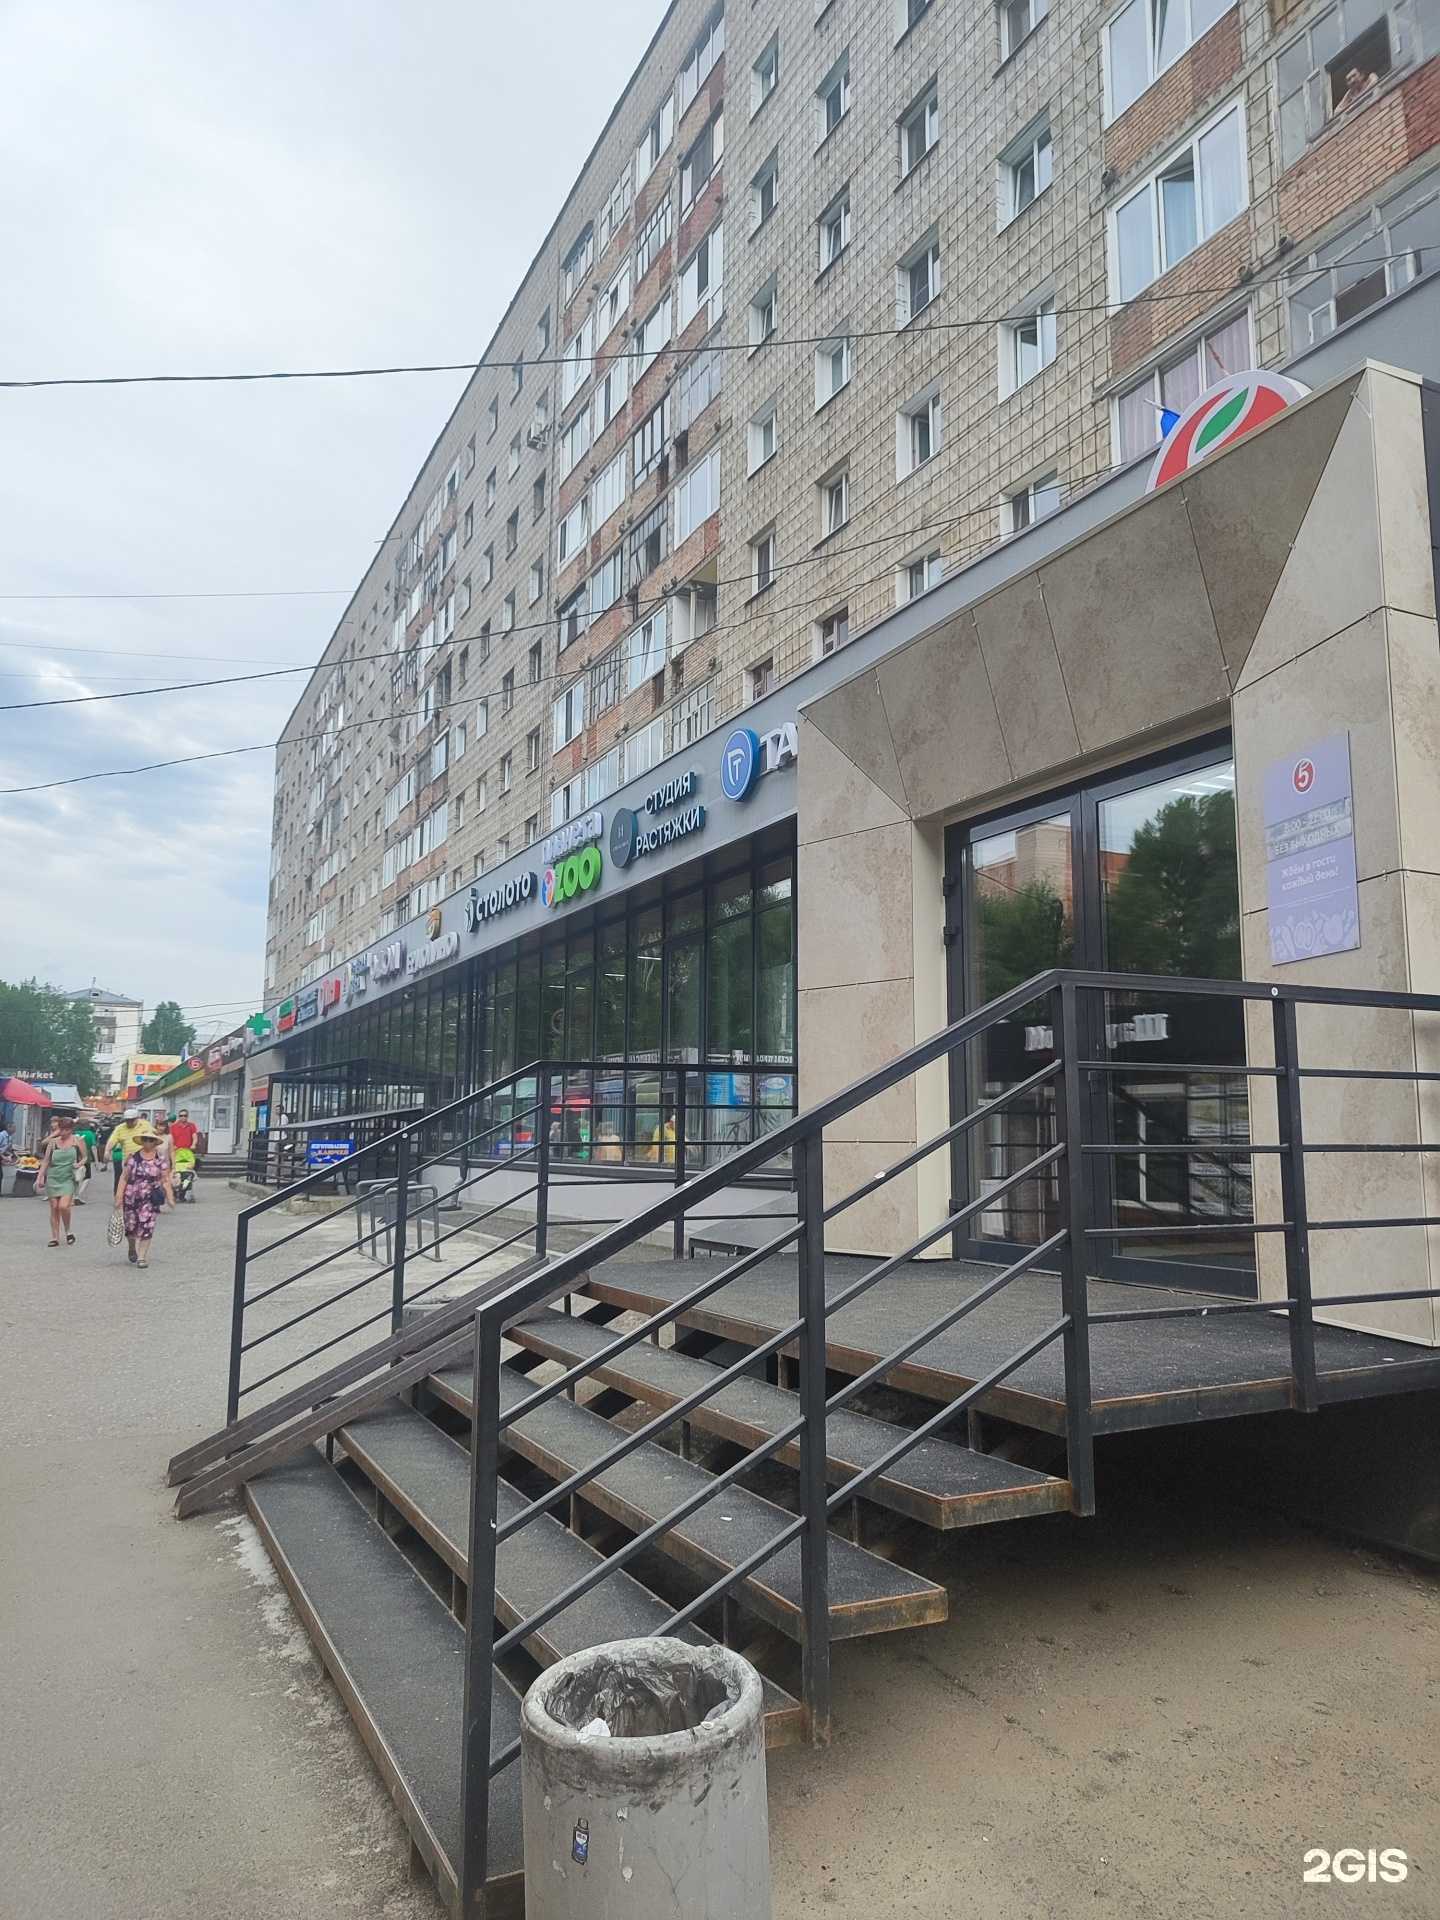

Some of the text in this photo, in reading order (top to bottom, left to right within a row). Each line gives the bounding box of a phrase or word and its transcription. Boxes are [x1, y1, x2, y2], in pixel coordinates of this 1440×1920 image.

[644, 771, 693, 816] СТУДИЯ
[635, 806, 704, 857] РАСТЯЖКИ
[553, 847, 603, 903] ZOO
